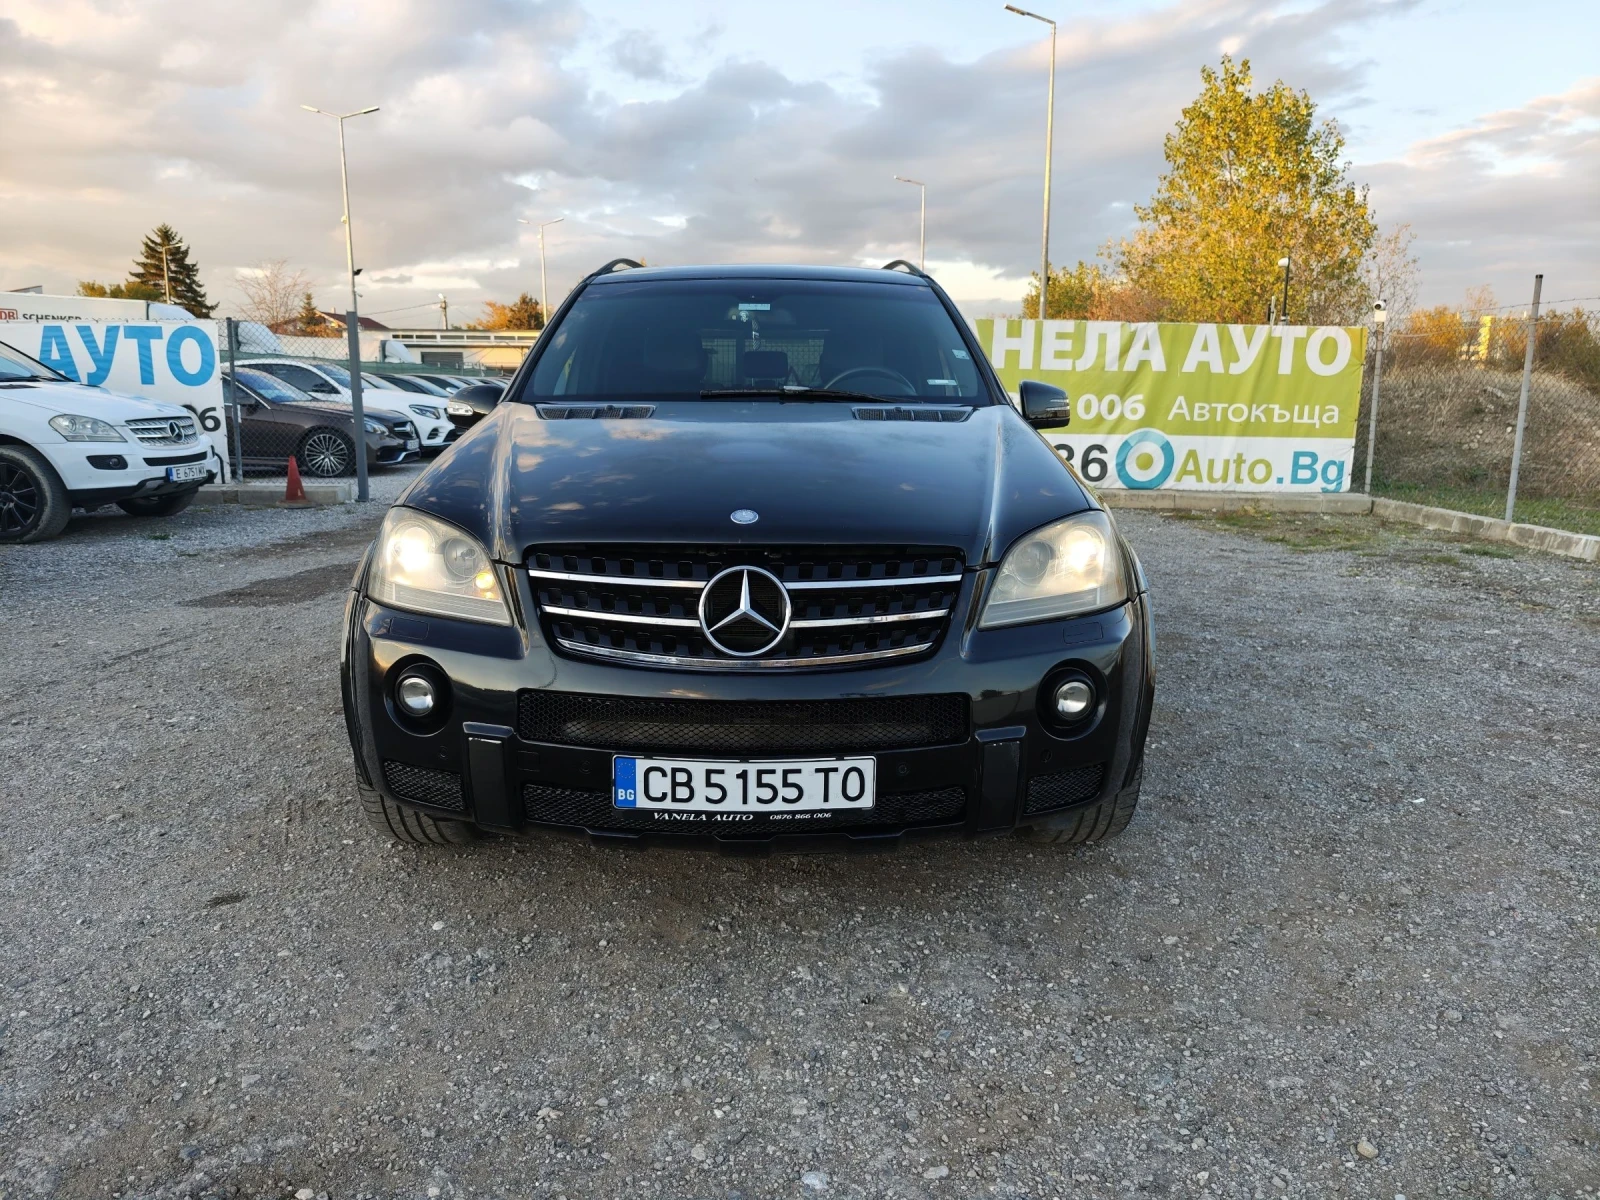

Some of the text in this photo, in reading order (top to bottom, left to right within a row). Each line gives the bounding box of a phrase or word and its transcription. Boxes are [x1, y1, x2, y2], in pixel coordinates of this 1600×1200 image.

[38, 325, 216, 387] АУТО
[970, 318, 1352, 376] НЕЛА АУТО
[182, 404, 221, 432] 6
[1076, 394, 1146, 420] 006
[1167, 395, 1340, 428] Автокъща
[617, 788, 635, 801] BG
[643, 767, 695, 803] CB
[705, 769, 804, 804] 5155
[653, 812, 707, 821] VANELA
[712, 813, 754, 821] AUTO
